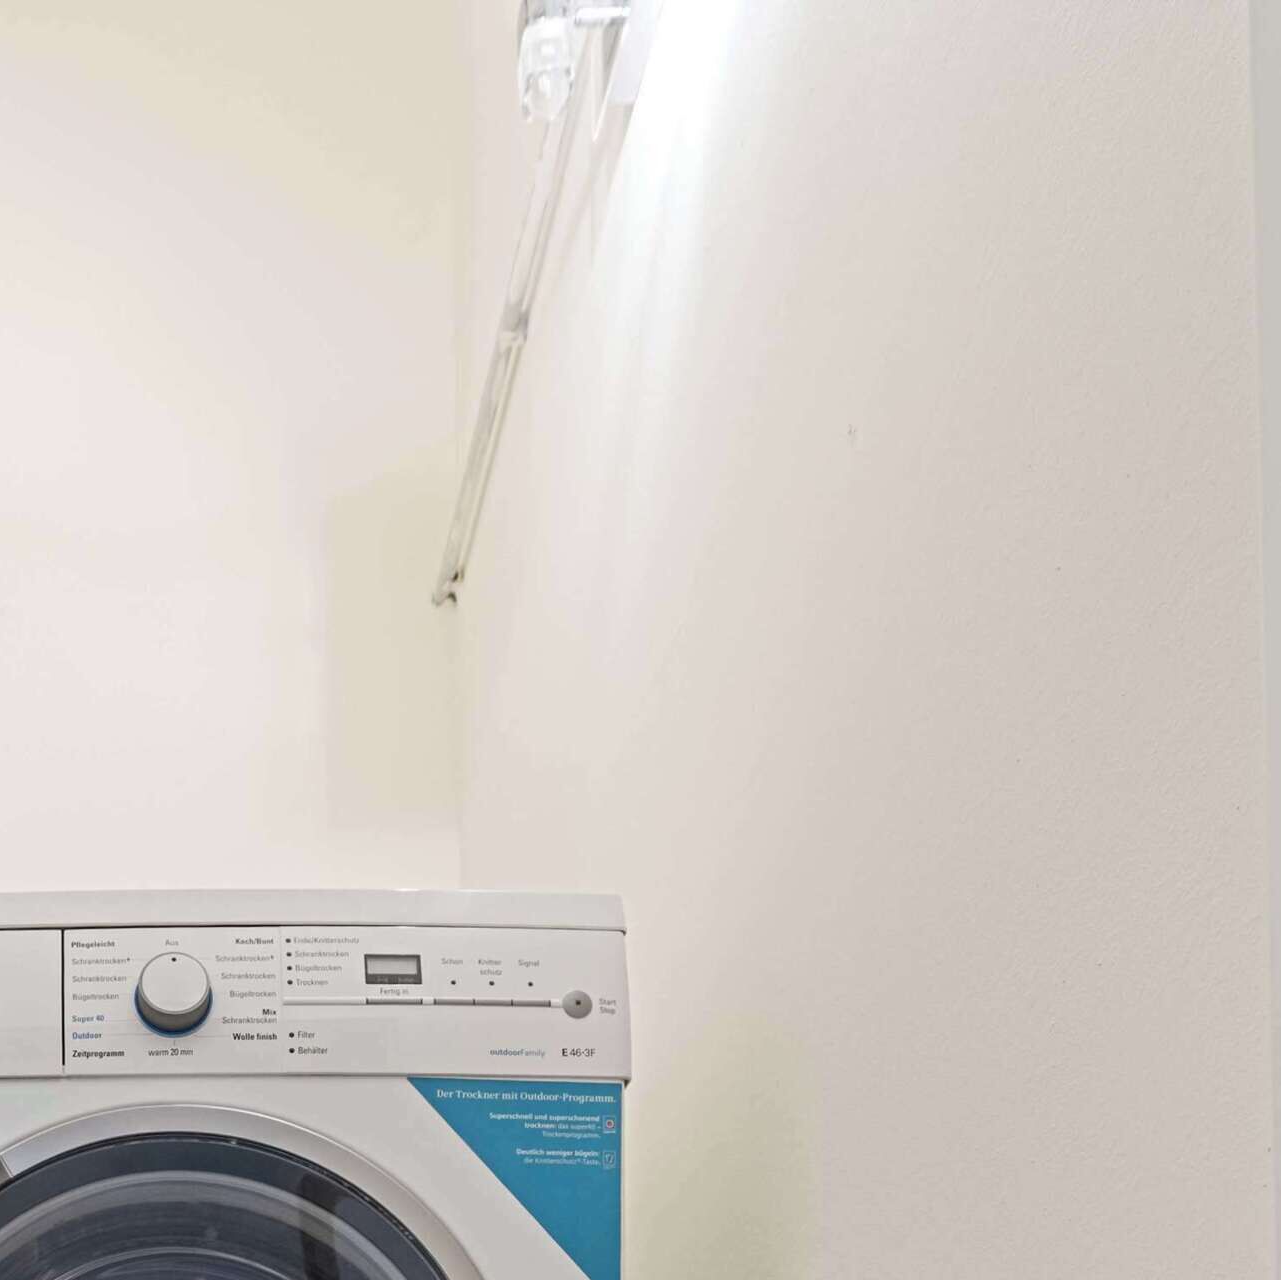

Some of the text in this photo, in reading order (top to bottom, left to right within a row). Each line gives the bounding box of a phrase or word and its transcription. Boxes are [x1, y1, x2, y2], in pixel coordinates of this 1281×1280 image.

[71, 940, 115, 949] Pflegeleicht
[518, 959, 540, 967] Signal
[221, 972, 276, 980] Schranktrocken
[229, 990, 277, 998] Bügeltrocken
[380, 987, 400, 996] Fertig
[72, 993, 119, 1001] Bügeltrocken
[599, 998, 616, 1006] Start
[262, 1008, 277, 1016] Mix
[72, 1015, 94, 1023] Super
[222, 1016, 278, 1024] Schranktrocken
[72, 1032, 102, 1040] Outdoor
[232, 1032, 278, 1041] Wolle finish
[297, 1031, 315, 1039] Filter
[72, 1050, 125, 1059] Zeitprogramm
[147, 1048, 194, 1057] warm 20 min
[297, 1047, 328, 1055] Behälter
[561, 1048, 568, 1057] E
[437, 1089, 616, 1105] Der Trockner mit Outdoor-Programm.
[489, 1112, 533, 1121] Superschnell
[549, 1114, 600, 1122] superschonend
